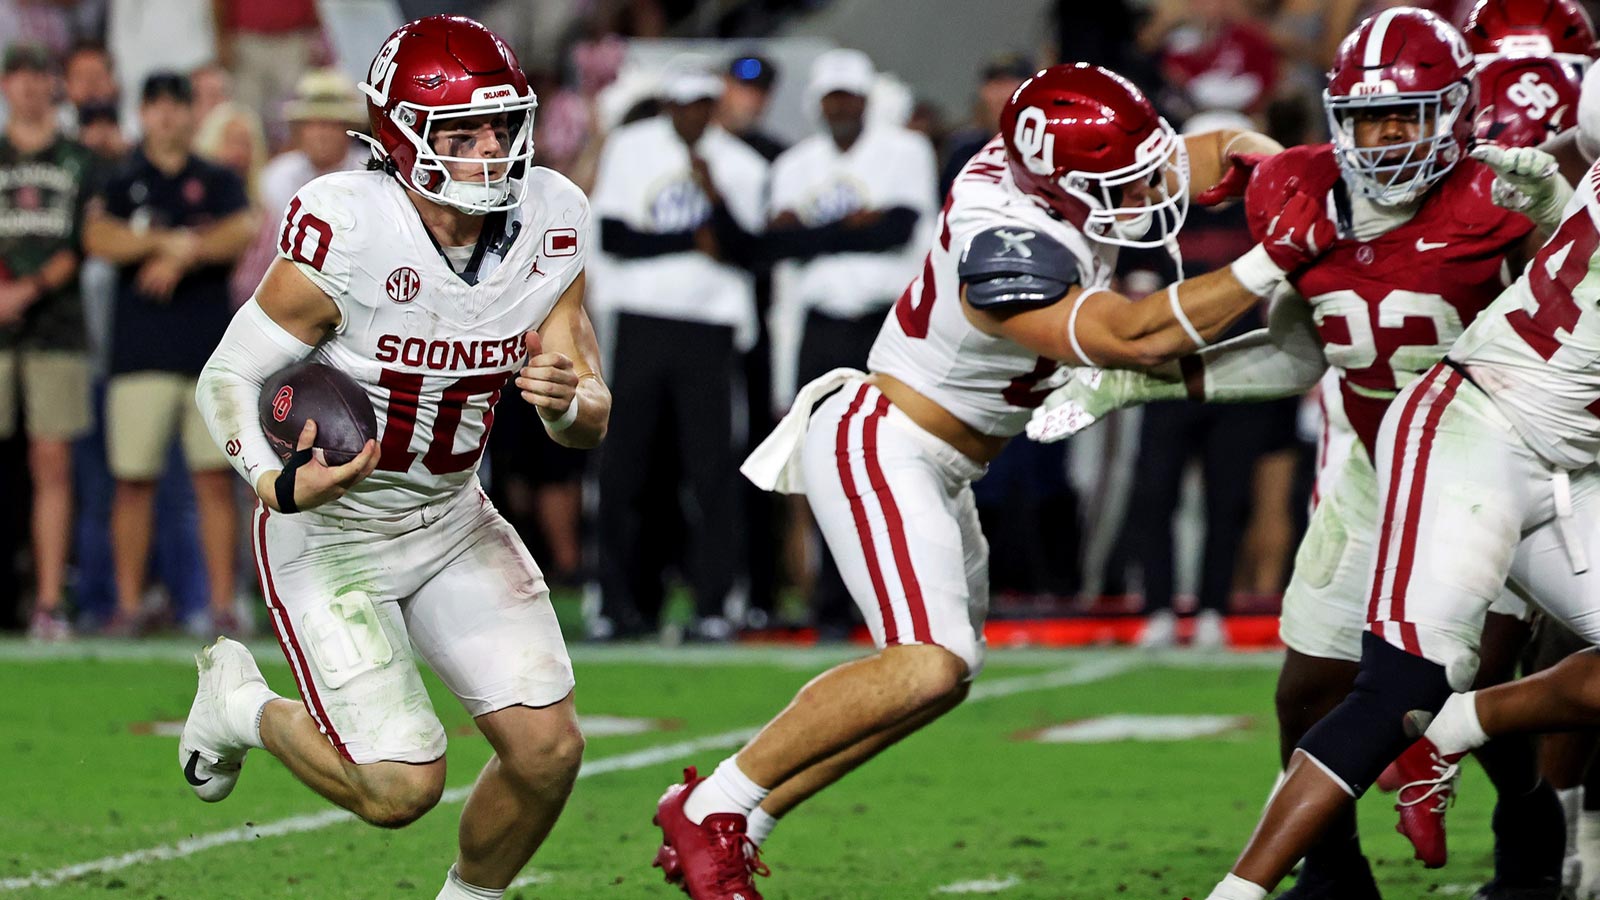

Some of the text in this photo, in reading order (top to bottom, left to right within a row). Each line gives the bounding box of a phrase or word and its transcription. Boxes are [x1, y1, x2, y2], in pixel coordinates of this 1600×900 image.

[483, 89, 511, 100] OKLAHOMA
[1014, 105, 1056, 176] OU
[280, 195, 333, 273] 10
[386, 267, 420, 303] SEC
[375, 332, 528, 371] SOONERS
[1309, 289, 1466, 390] 22
[374, 368, 513, 475] 10
